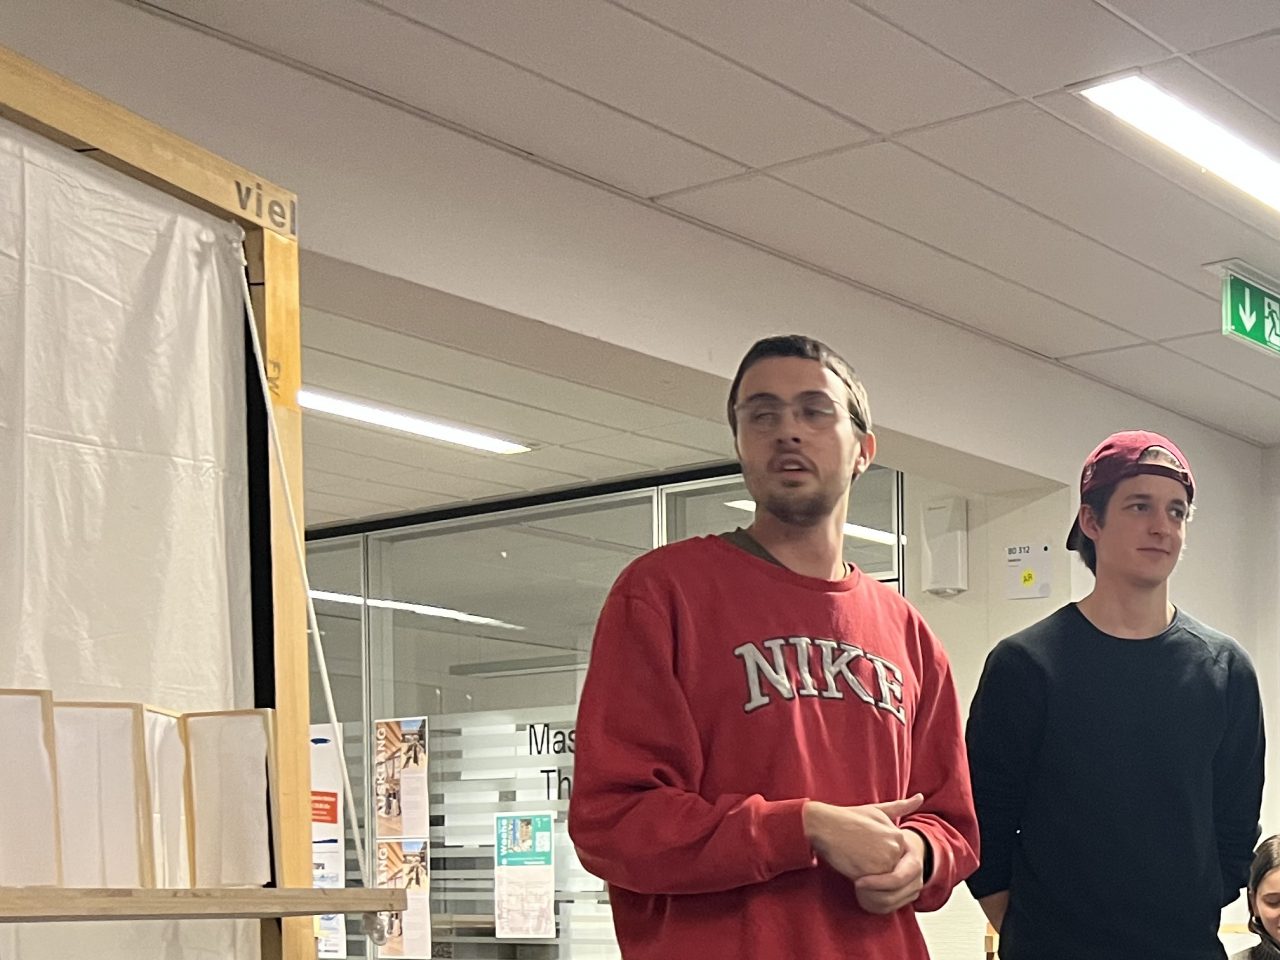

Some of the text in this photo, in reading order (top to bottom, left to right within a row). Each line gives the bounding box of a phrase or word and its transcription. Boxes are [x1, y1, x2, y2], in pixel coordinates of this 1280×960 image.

[234, 179, 296, 236] viel
[734, 636, 906, 726] NIKE
[528, 723, 577, 755] Mas
[540, 769, 572, 800] Th
